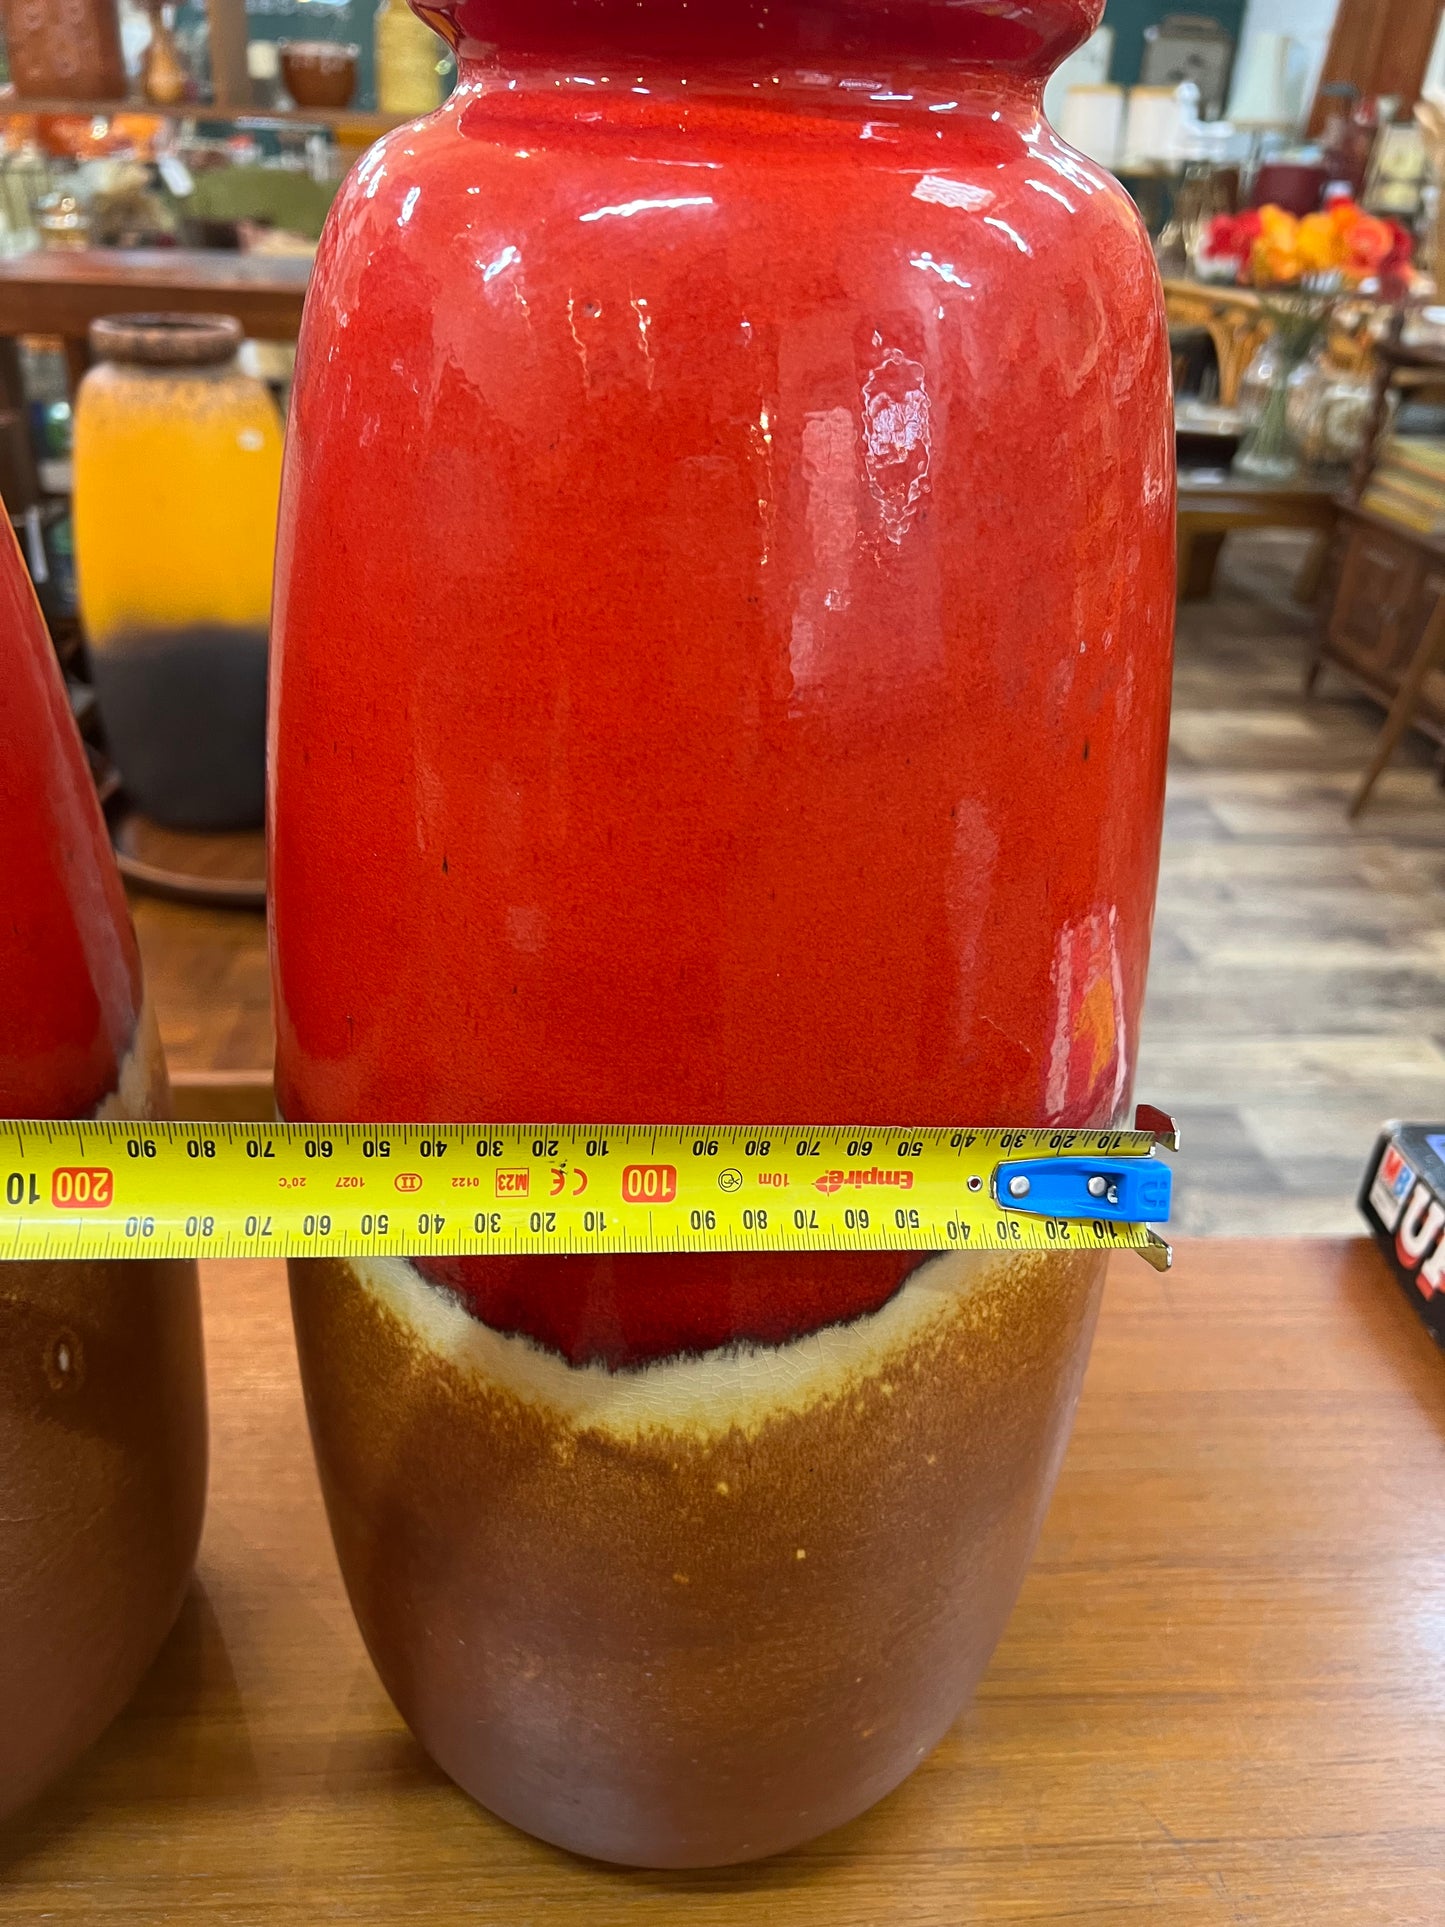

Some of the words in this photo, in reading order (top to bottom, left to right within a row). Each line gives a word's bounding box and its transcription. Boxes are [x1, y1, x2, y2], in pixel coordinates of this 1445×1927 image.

[127, 1140, 156, 1157] 90
[187, 1140, 215, 1157] 80
[247, 1140, 275, 1157] 70
[305, 1140, 333, 1157] 60
[363, 1140, 390, 1157] 50
[420, 1140, 447, 1157] 40
[476, 1140, 503, 1157] 30
[532, 1140, 558, 1157] 20
[586, 1140, 609, 1156] 10
[692, 1140, 718, 1156] 90
[745, 1140, 771, 1156] 80
[796, 1140, 820, 1156] 70
[847, 1140, 873, 1156] 60
[897, 1141, 923, 1157] 50
[951, 1133, 976, 1148] 40
[1001, 1134, 1027, 1149] 30
[1050, 1134, 1076, 1149] 20
[1098, 1134, 1122, 1149] 10
[56, 1172, 109, 1202] 200
[278, 1177, 306, 1189] 20°C
[335, 1177, 365, 1188] 1027
[452, 1177, 480, 1188] 0122
[497, 1174, 528, 1191] M23
[550, 1168, 588, 1196] CE
[627, 1169, 671, 1197] 100
[759, 1173, 790, 1188] 10m
[830, 1167, 914, 1191] Empire
[6, 1173, 40, 1205] 10
[125, 1216, 155, 1237] 90
[185, 1216, 215, 1236] 80
[245, 1216, 272, 1236] 70
[303, 1215, 331, 1236] 60
[361, 1214, 389, 1235] 50
[418, 1214, 445, 1234] 40
[474, 1213, 501, 1233] 30
[530, 1212, 556, 1233] 20
[584, 1211, 607, 1232] 10
[690, 1210, 716, 1230] 90
[743, 1209, 767, 1229] 80
[794, 1209, 819, 1229] 70
[845, 1209, 870, 1229] 60
[895, 1209, 920, 1229] 50
[947, 1221, 971, 1240] 40
[996, 1221, 1020, 1240] 30
[1045, 1220, 1070, 1240] 20
[1093, 1220, 1117, 1239] 10
